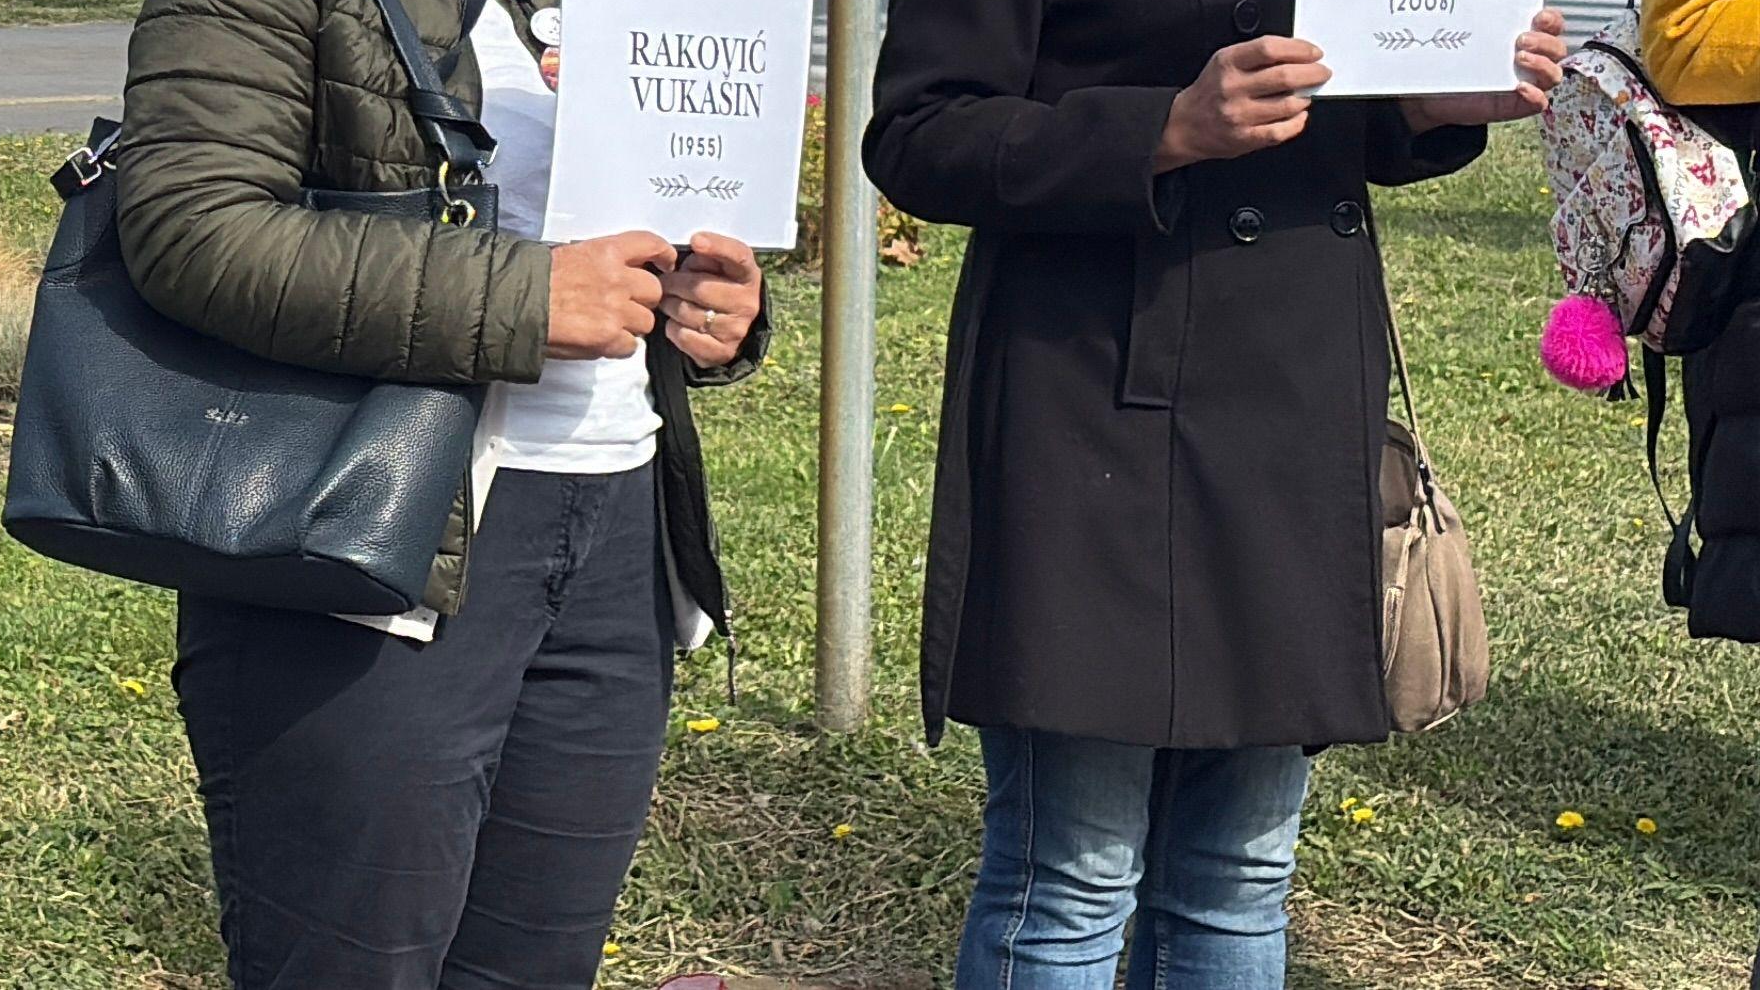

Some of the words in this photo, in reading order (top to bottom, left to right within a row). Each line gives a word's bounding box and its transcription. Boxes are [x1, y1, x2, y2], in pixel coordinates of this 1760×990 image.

[629, 30, 767, 74] RAKOVIĆ
[629, 74, 764, 119] VUKAŠIN
[670, 132, 723, 160] (1955)
